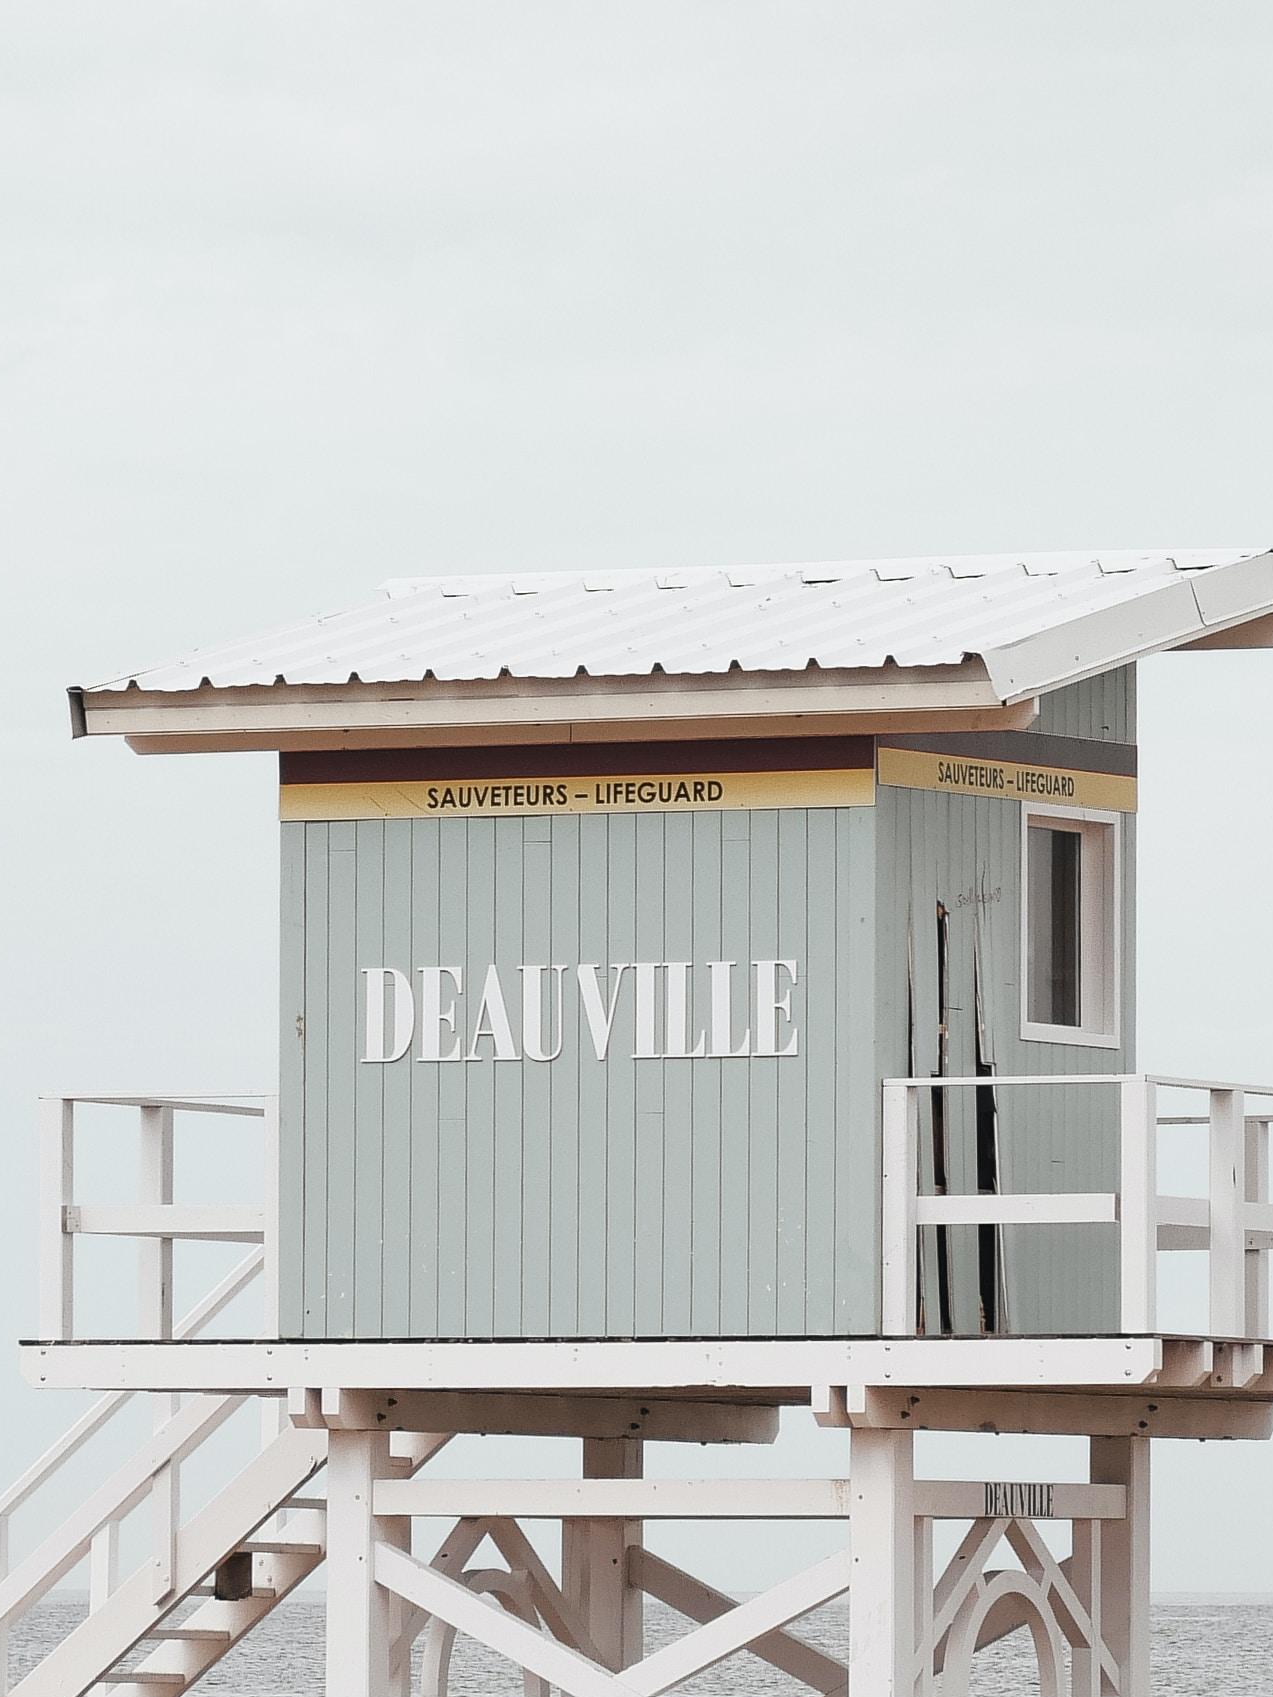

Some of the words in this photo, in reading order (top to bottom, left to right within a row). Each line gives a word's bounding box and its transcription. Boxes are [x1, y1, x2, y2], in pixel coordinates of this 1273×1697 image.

[427, 784, 568, 809] SAUVETEURS
[595, 780, 724, 805] LIFEGUARD
[937, 761, 1005, 790] SAUVETEURS
[1016, 770, 1074, 798] LIFEGUARD
[360, 959, 799, 1063] DEAUVILLE
[984, 1482, 1055, 1518] DEAUVILLE
